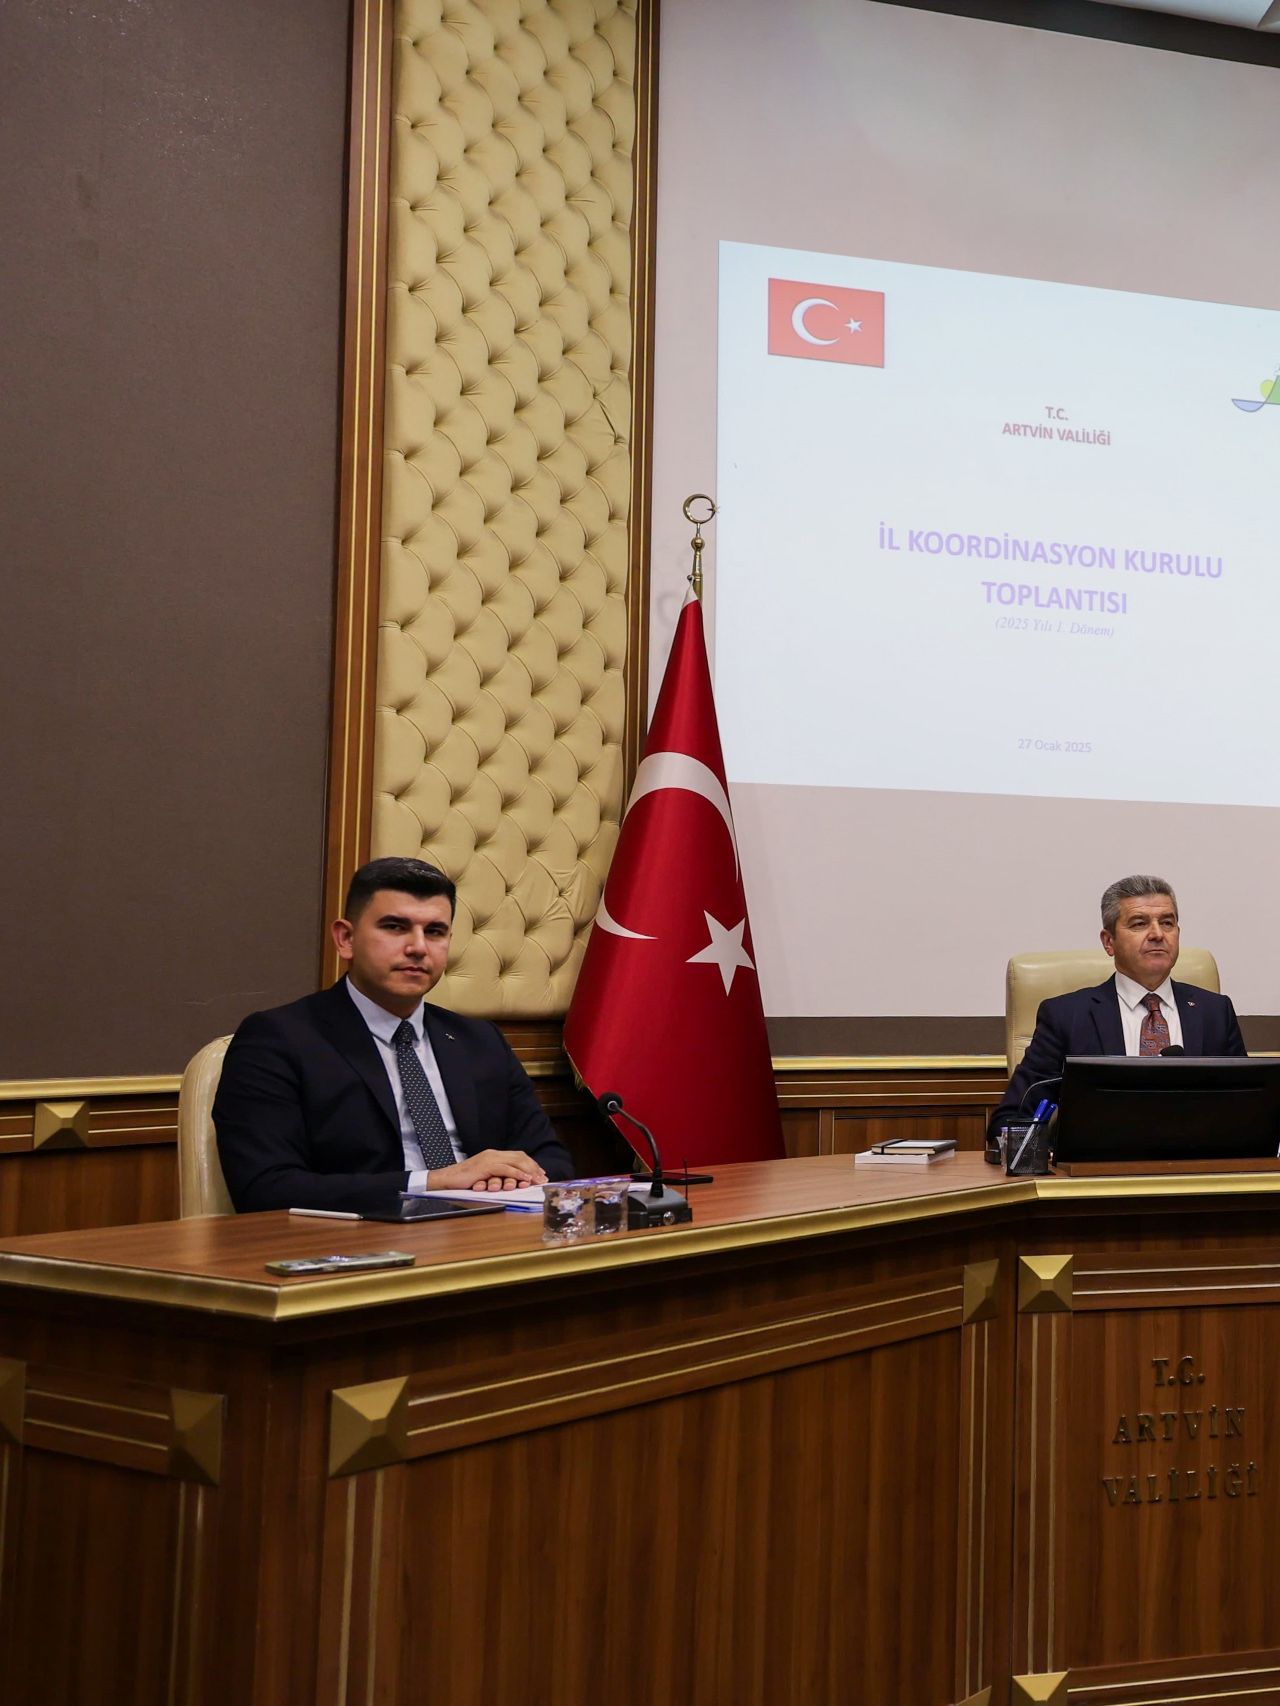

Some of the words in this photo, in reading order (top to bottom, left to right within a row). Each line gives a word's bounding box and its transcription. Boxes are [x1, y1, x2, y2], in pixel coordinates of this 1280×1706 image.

[1045, 406, 1069, 421] T.C.
[1002, 422, 1053, 440] ARTVİN
[1057, 427, 1111, 446] VALİLİĞİ
[878, 521, 900, 551] İL
[908, 529, 1116, 569] KOORDİNASYON
[1124, 549, 1223, 579] KURULU
[982, 581, 1128, 614] TOPLANTISI
[994, 616, 1030, 631] (2025
[1070, 622, 1115, 639] Dönem)
[1018, 738, 1032, 750] 27
[1034, 739, 1062, 752] Ocak
[1065, 741, 1092, 753] 2025
[1152, 1355, 1206, 1387] T.C.
[1112, 1404, 1245, 1445] ARTVİN
[1102, 1461, 1257, 1507] VALİLİĞİ
